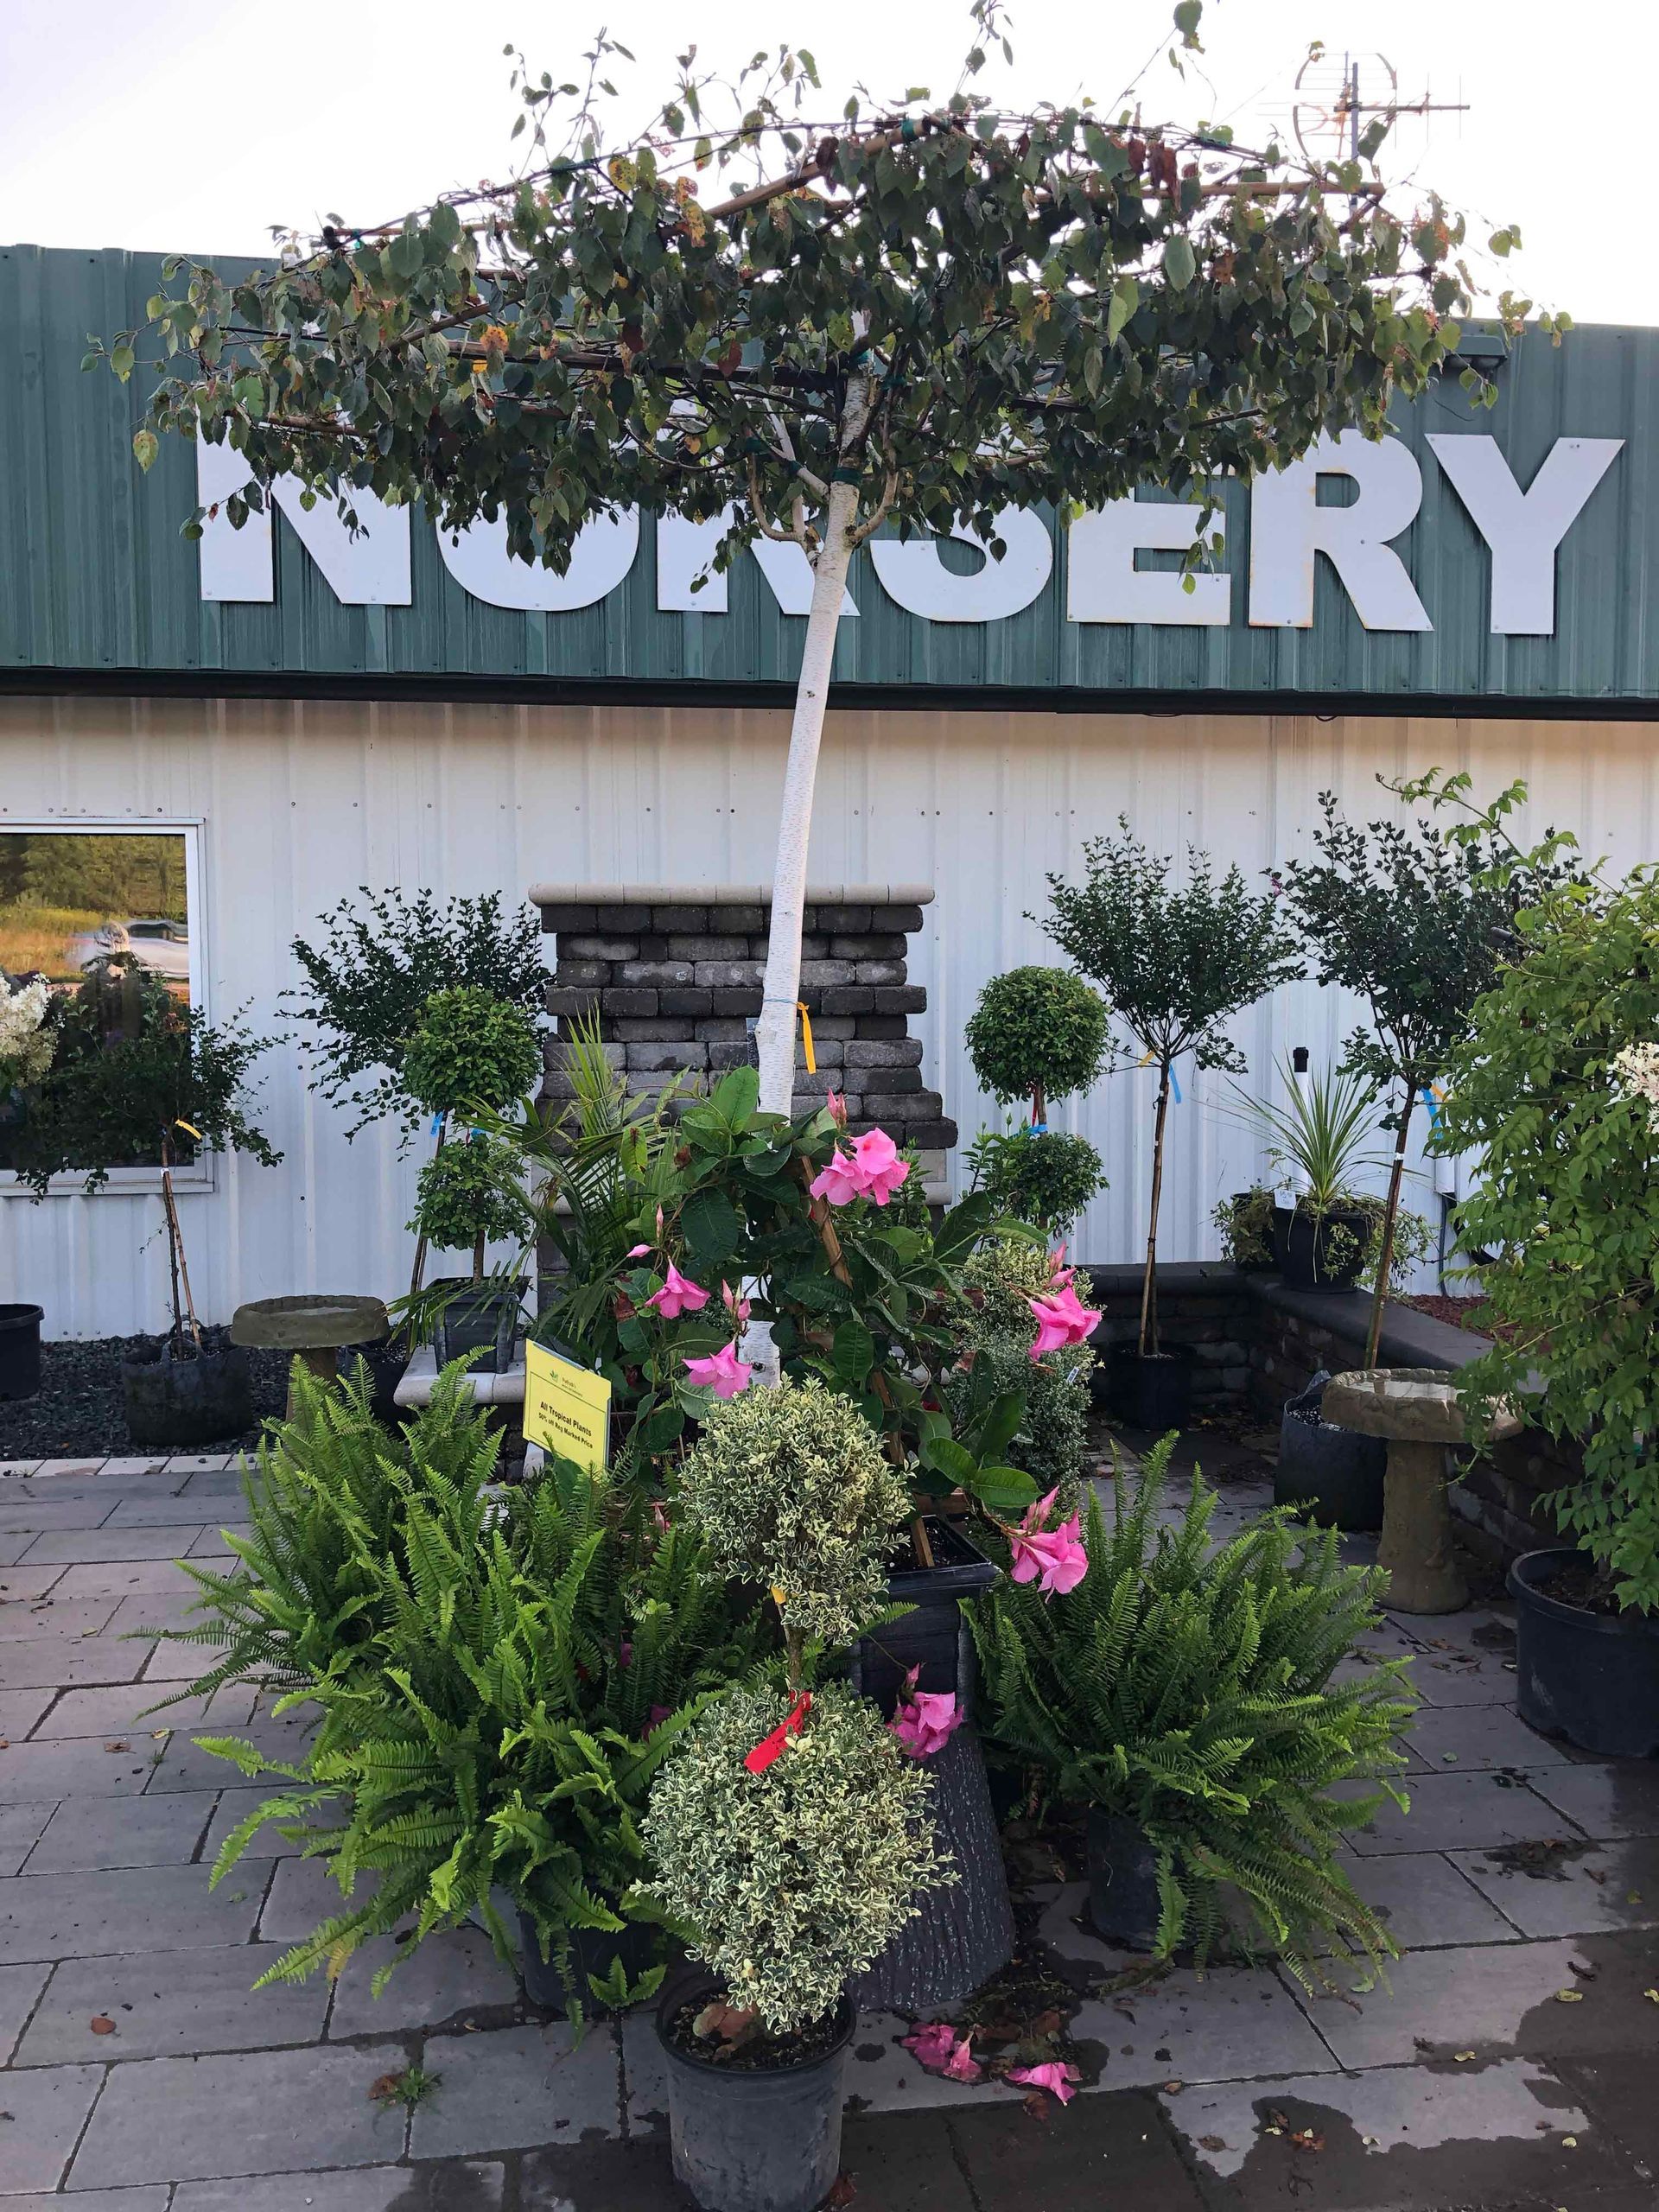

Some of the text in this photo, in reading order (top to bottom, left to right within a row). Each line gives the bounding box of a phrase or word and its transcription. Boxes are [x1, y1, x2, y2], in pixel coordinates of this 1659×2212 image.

[549, 1406, 571, 1425] Tropical
[573, 1419, 592, 1437] Plants
[563, 1427, 581, 1441] Marked
[581, 1437, 593, 1448] Price
